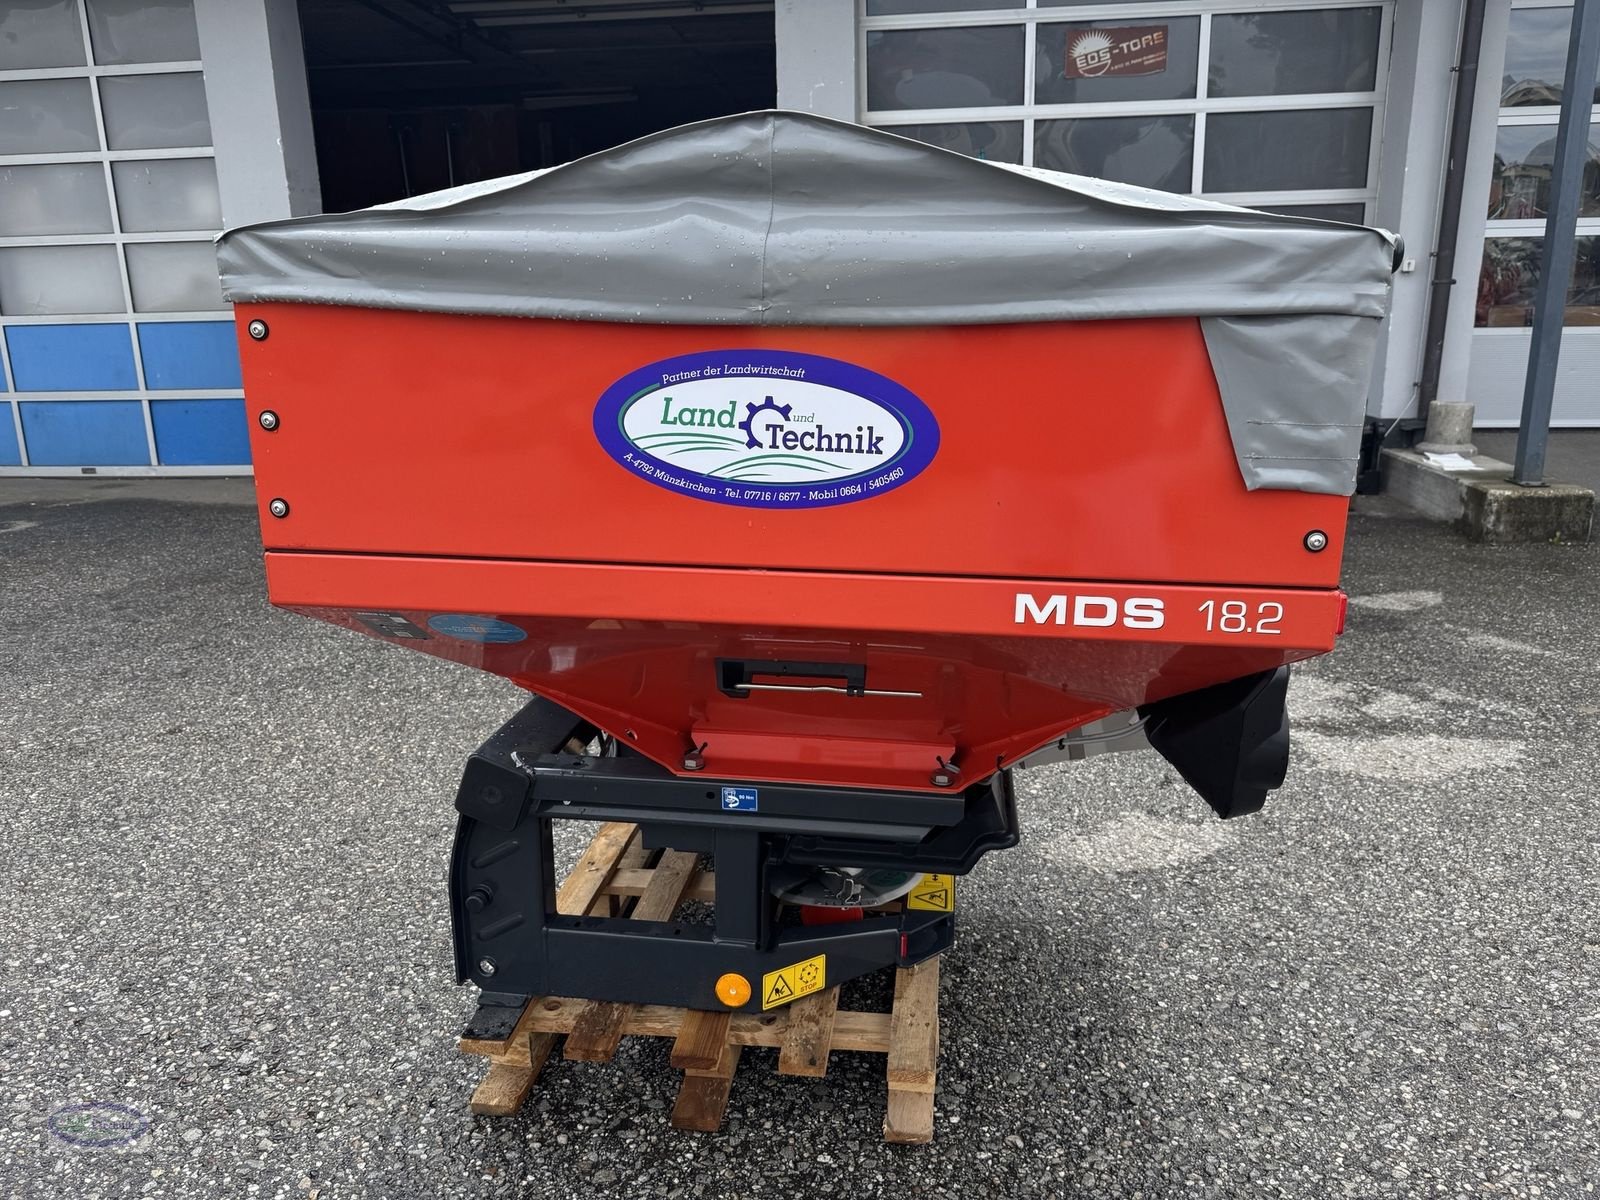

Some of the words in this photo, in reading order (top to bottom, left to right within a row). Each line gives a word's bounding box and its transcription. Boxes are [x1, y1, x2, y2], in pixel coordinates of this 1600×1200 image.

[662, 369, 701, 384] Partner
[703, 366, 721, 376] der
[724, 364, 805, 378] Landwirtschaft
[660, 397, 737, 428] Land
[793, 412, 815, 423] und
[765, 424, 884, 455] Technik
[623, 452, 653, 475] A-4792
[654, 469, 716, 495] Münzkirchen
[724, 487, 742, 499] Tel.
[744, 490, 771, 501] 07716
[778, 491, 801, 501] 6677
[808, 488, 838, 501] Mobil
[839, 484, 862, 497] 0664
[869, 466, 905, 490] 5405460
[1014, 593, 1165, 629] MDS
[1198, 600, 1284, 634] 18.2
[800, 981, 818, 993] STOP
